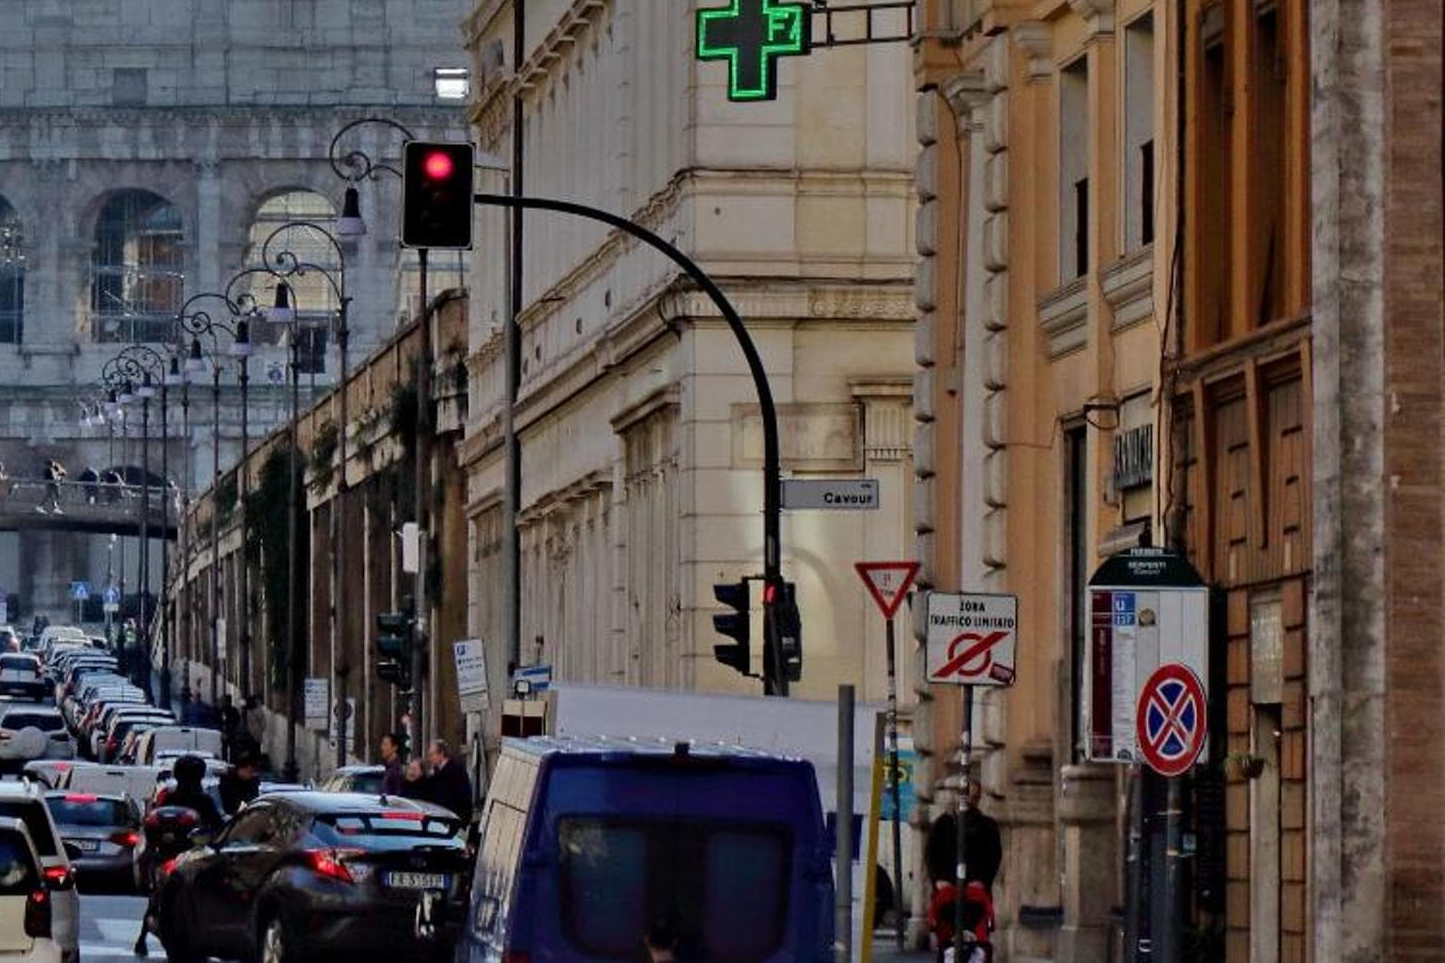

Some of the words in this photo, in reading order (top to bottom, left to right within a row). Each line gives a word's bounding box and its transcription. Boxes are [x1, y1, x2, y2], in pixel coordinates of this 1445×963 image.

[824, 493, 872, 503] Cavour
[959, 600, 986, 612] ZONA
[930, 615, 972, 627] TRAFFICO
[974, 617, 1015, 629] LIMITATO
